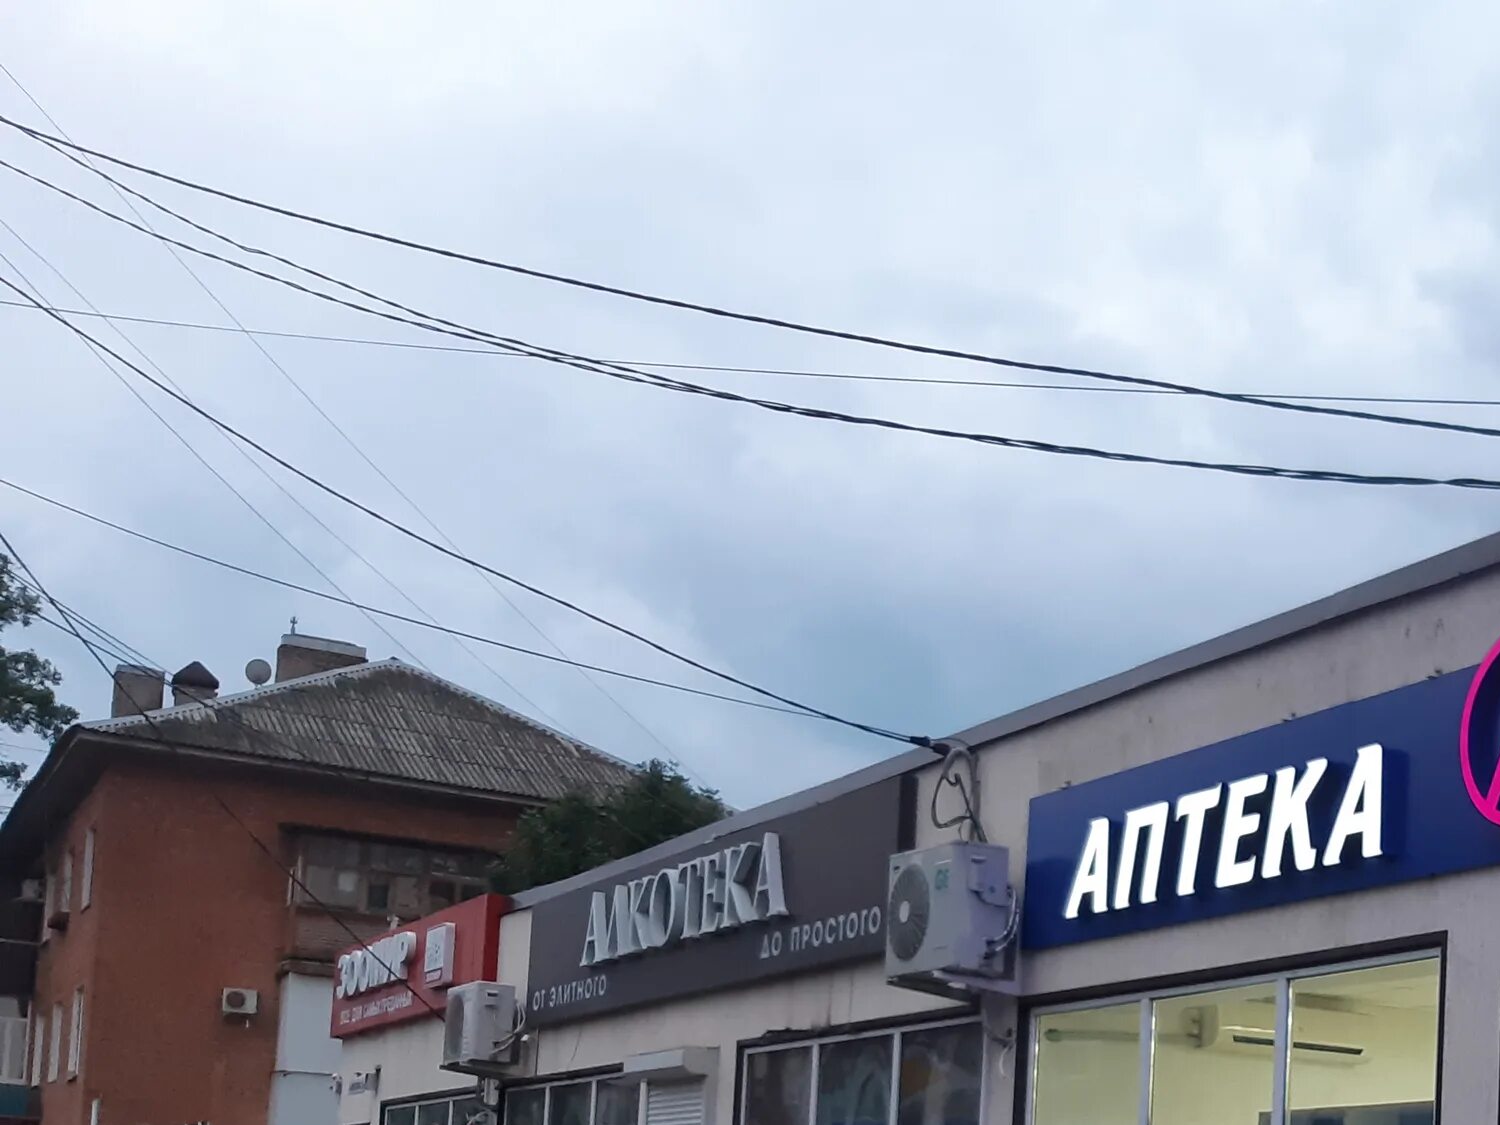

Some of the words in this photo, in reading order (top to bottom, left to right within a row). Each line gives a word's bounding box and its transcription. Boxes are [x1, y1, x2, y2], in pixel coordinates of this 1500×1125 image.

[1064, 742, 1383, 919] АПТЕКА
[579, 832, 789, 967] АЛКОТЕКА
[760, 931, 782, 959] ДО
[790, 906, 881, 951] ПРОСТОГО
[532, 990, 546, 1010] ОТ
[549, 974, 607, 1007] ЭЛИТНОГО
